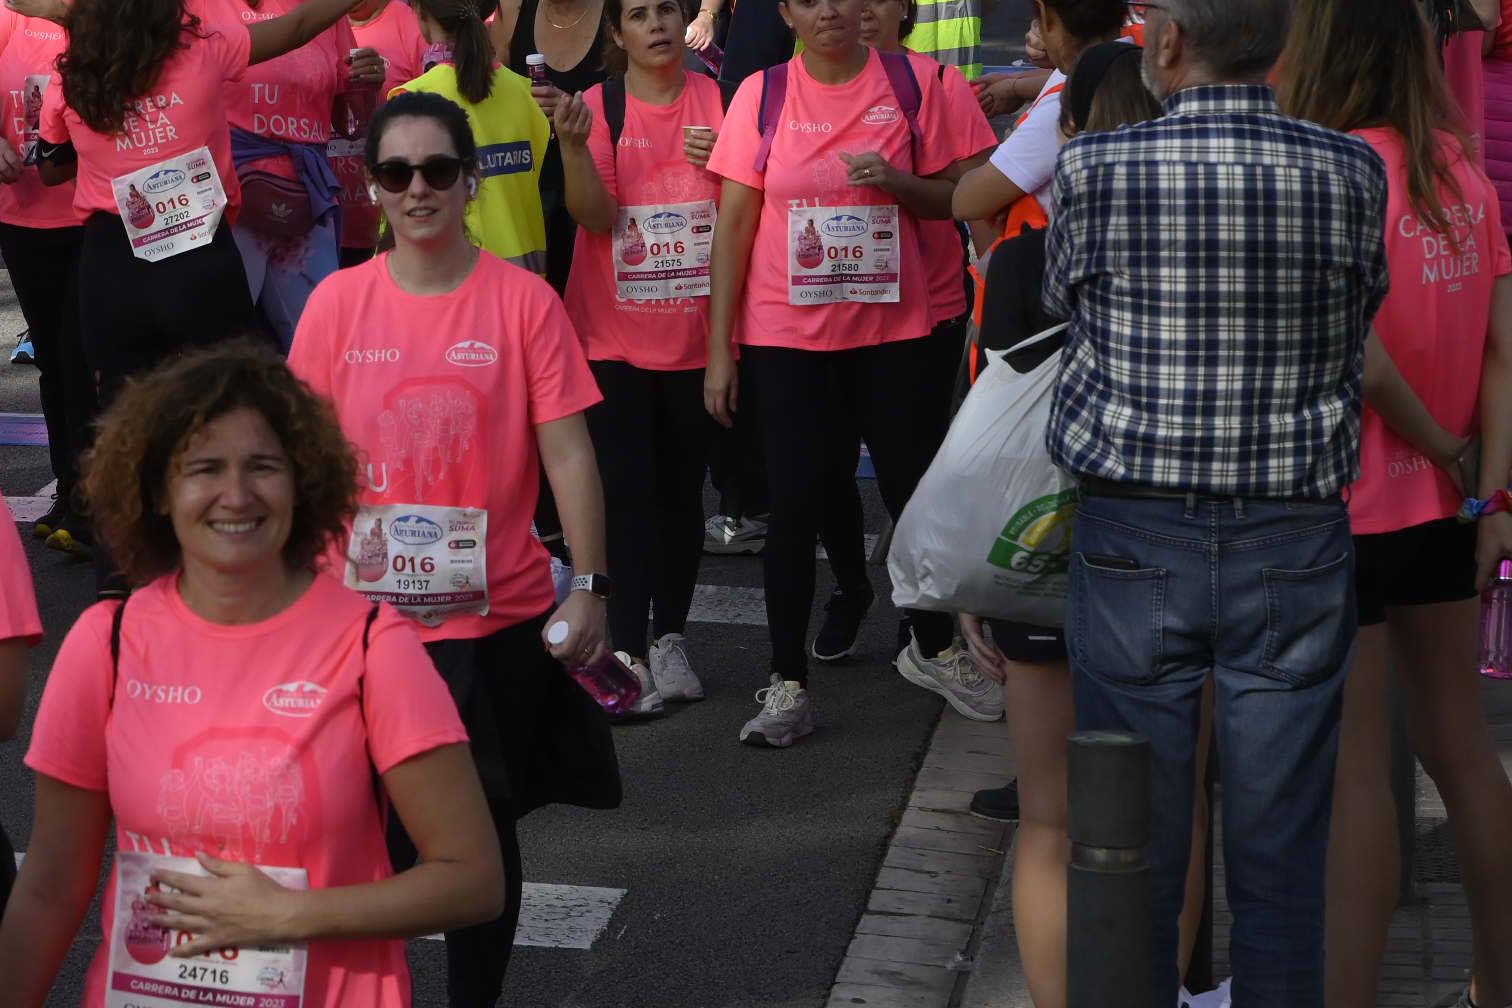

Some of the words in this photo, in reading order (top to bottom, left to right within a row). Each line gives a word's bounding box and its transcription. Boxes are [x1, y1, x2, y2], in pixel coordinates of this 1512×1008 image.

[250, 83, 279, 105] TU
[147, 111, 171, 129] LA
[253, 114, 325, 141] DORSAL
[788, 119, 833, 134] OYSHO
[116, 127, 179, 153] MUJER
[155, 193, 190, 215] 016
[163, 210, 191, 226] 27202
[824, 224, 865, 233] ASTURIANA
[144, 242, 175, 258] OYSHO
[649, 241, 685, 256] 016
[827, 245, 864, 260] 016
[1422, 235, 1450, 259] DE
[654, 258, 682, 269] 21575
[831, 263, 859, 273] 21580
[1422, 252, 1479, 284] MUJER
[626, 285, 658, 294] OYSHO
[800, 289, 833, 299] OYSHO
[345, 347, 400, 364] OYSHO
[392, 554, 435, 574] 016
[396, 579, 430, 591] 19137
[398, 595, 410, 603] DE
[126, 679, 202, 705] OYSHO
[178, 964, 229, 985] 24716
[129, 978, 180, 998] CARRERA
[180, 988, 197, 1000] DE
[198, 990, 214, 1002] LA
[215, 993, 255, 1008] MUJER
[259, 996, 285, 1008] 2023
